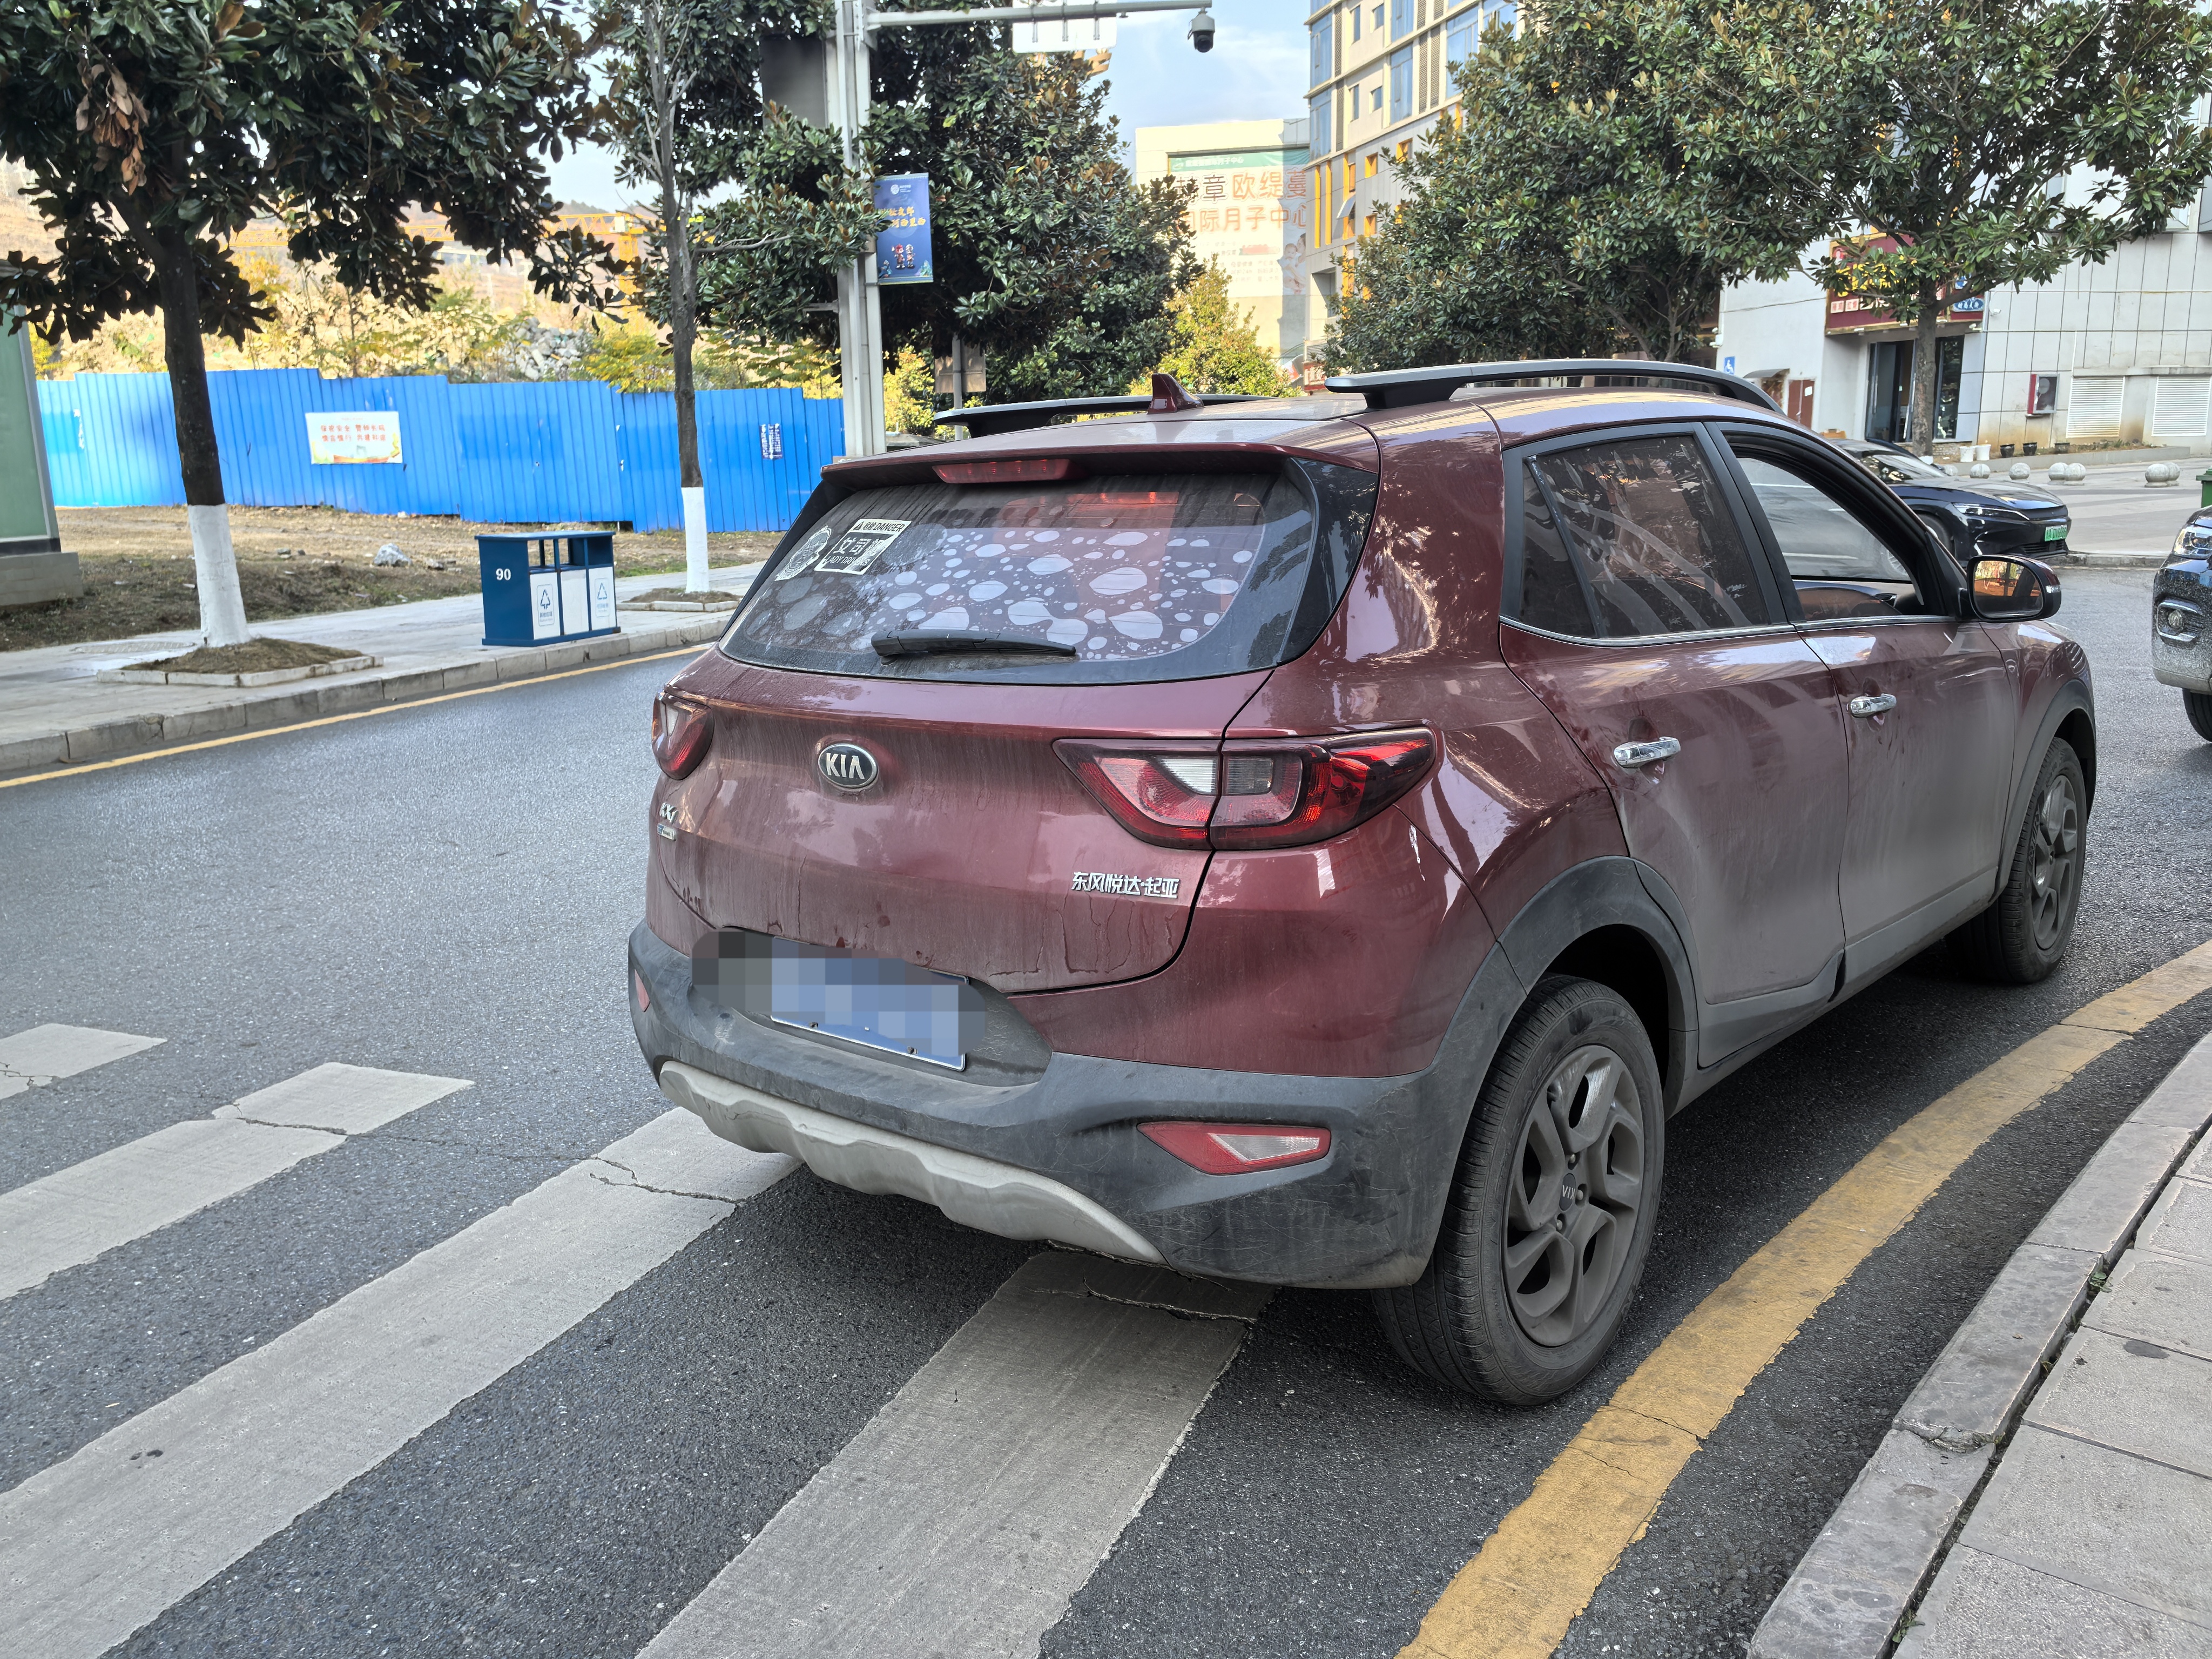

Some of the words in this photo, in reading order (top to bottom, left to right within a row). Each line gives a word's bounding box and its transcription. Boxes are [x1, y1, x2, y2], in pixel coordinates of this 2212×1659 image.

[873, 523, 905, 532] DANGER
[824, 555, 845, 564] LADY
[496, 568, 511, 581] 90
[826, 752, 865, 779] KIA
